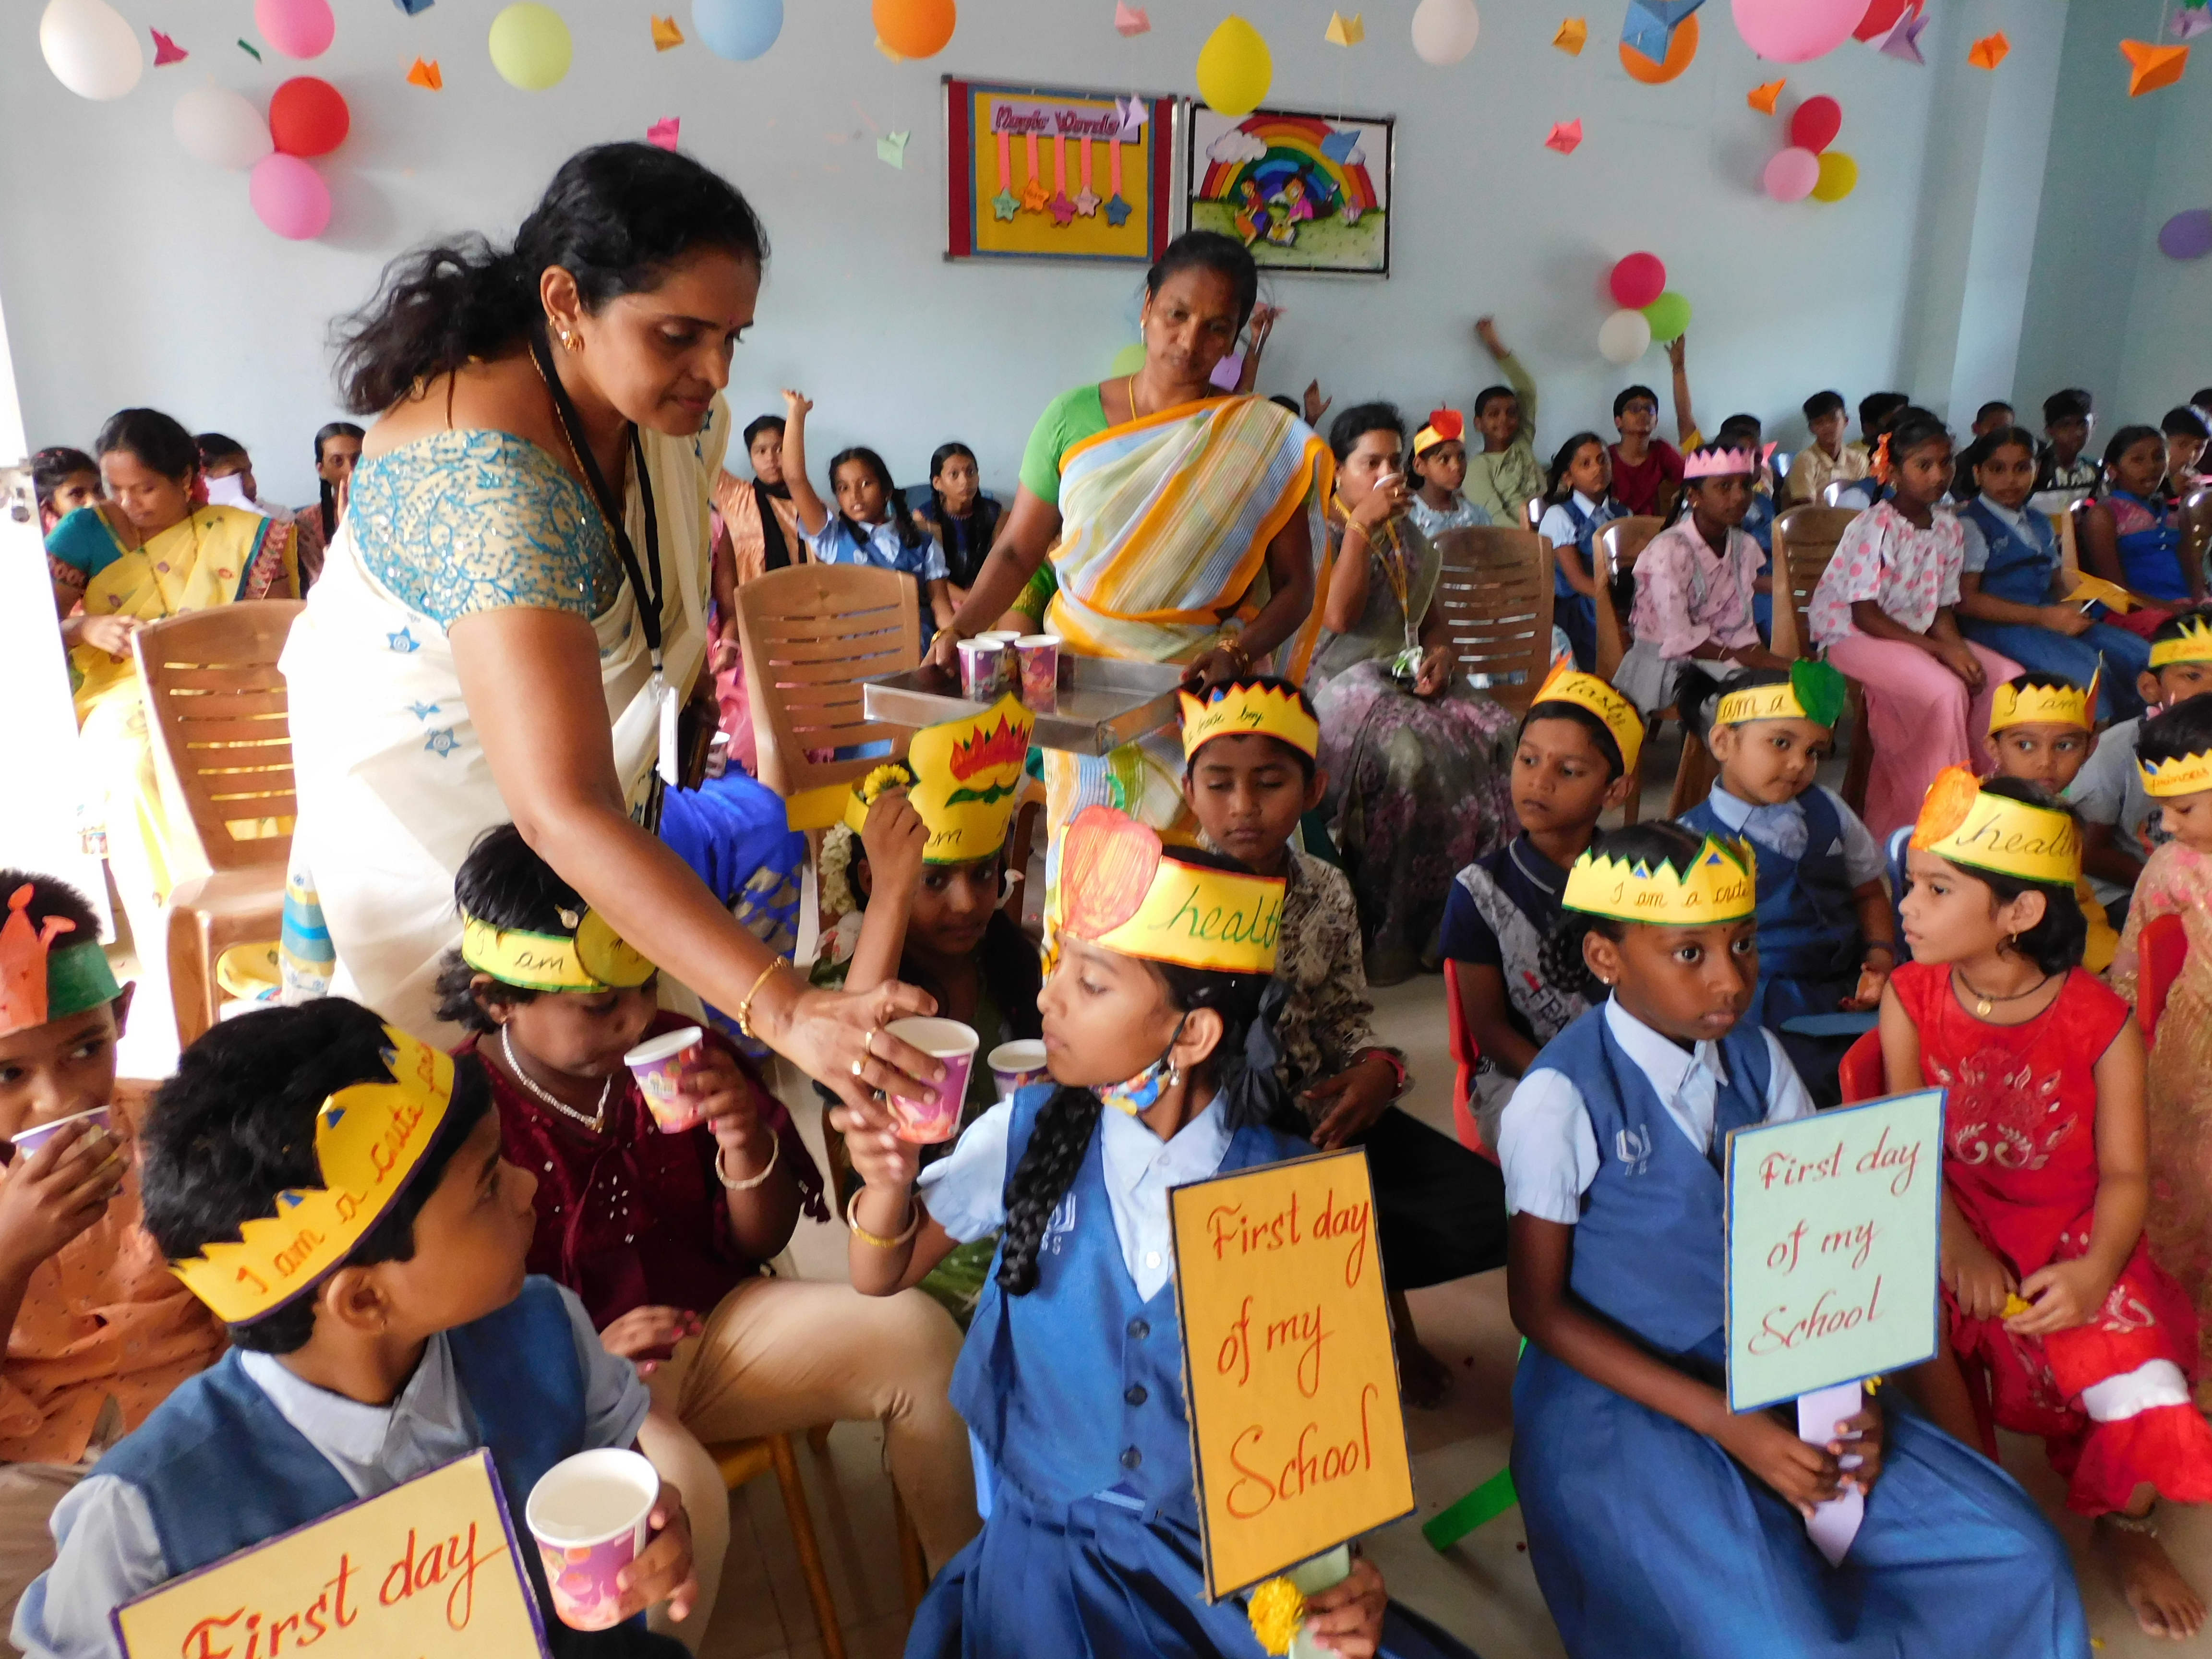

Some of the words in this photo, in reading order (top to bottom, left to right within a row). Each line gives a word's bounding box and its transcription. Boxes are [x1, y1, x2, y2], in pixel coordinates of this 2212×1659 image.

[1722, 696, 1759, 720] am
[1766, 694, 1787, 713] a
[2038, 697, 2078, 711] am
[1634, 891, 1668, 908] am
[1682, 890, 1702, 907] a
[515, 951, 564, 974] am
[1759, 1141, 1844, 1190] First
[1856, 1125, 1921, 1197] day
[273, 1229, 326, 1278] am
[335, 1190, 369, 1225] a
[1207, 1188, 1302, 1261] First
[1313, 1188, 1370, 1289] day
[1767, 1218, 1809, 1276] of
[1821, 1219, 1880, 1271] my
[1216, 1295, 1254, 1388] of
[1266, 1303, 1335, 1399] my
[1747, 1273, 1884, 1356] School
[1226, 1382, 1379, 1520] School
[181, 1552, 361, 1659] First
[378, 1520, 510, 1632] day
